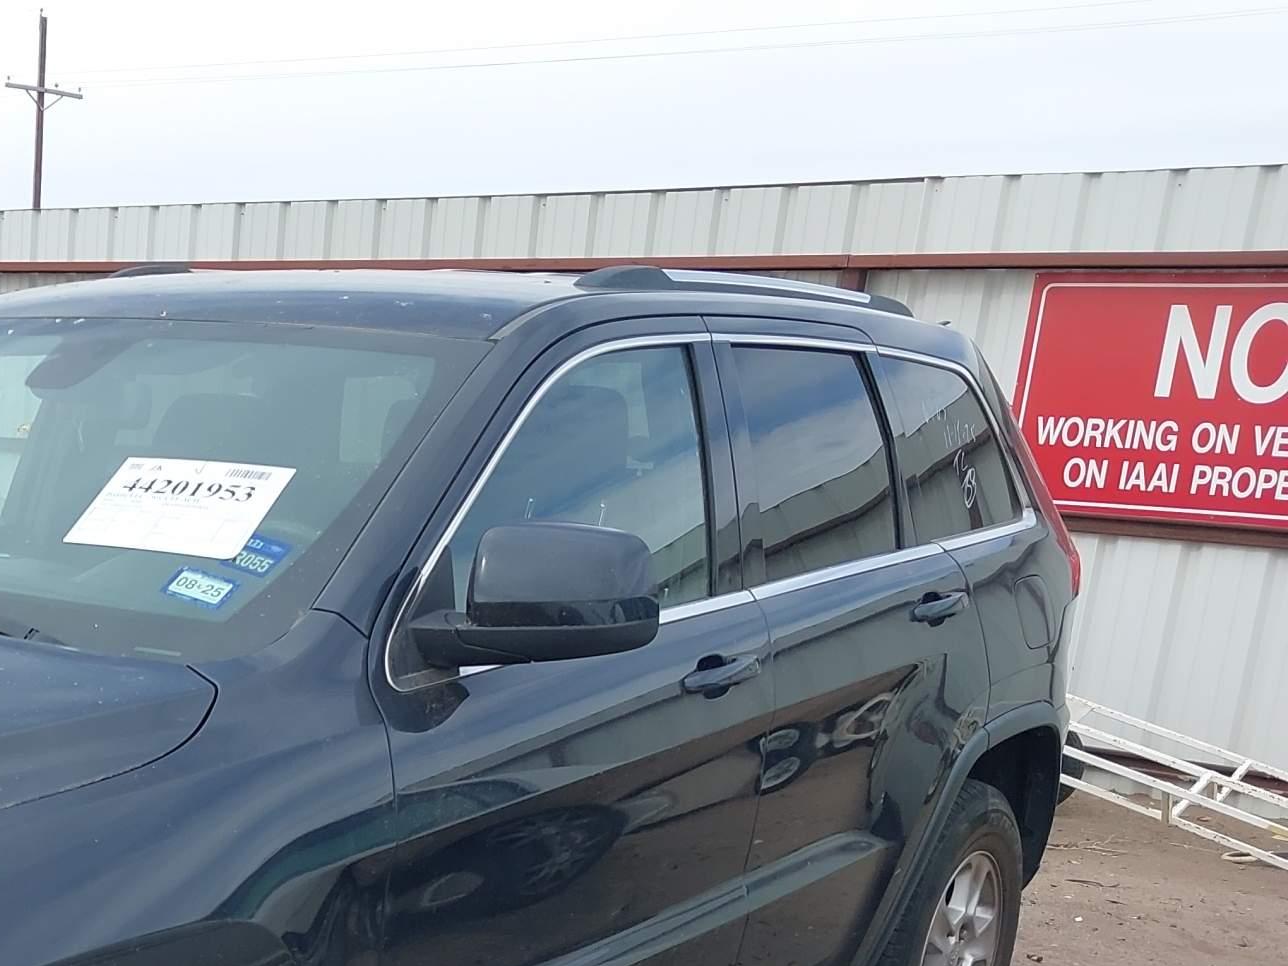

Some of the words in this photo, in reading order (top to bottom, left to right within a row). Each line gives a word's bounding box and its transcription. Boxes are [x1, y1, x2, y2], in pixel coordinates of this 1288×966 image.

[1036, 415, 1179, 452] WORKING
[1191, 422, 1241, 455] ON
[1254, 425, 1288, 458] VE
[122, 477, 257, 503] 44201953
[1063, 456, 1109, 489] ON
[1118, 460, 1180, 494] IAAI
